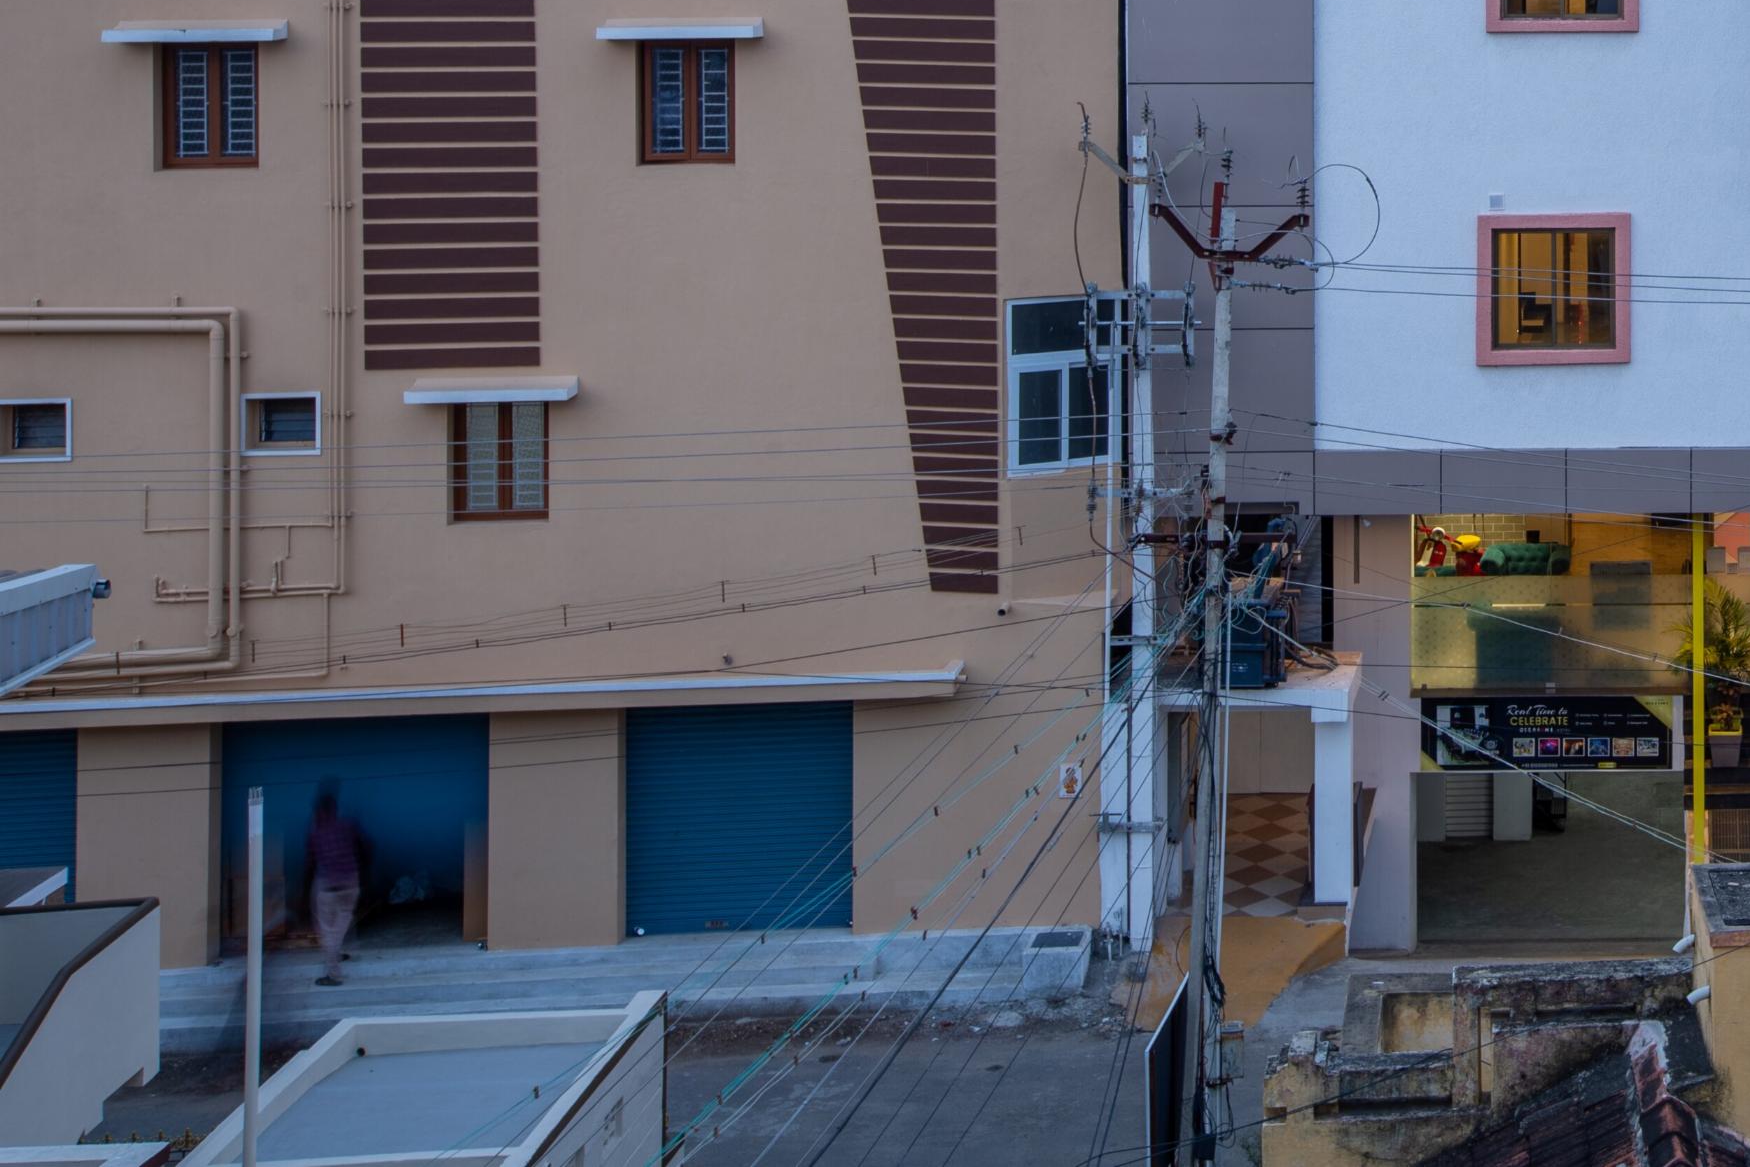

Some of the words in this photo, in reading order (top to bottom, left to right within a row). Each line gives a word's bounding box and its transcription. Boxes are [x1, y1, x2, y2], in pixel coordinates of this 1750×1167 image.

[1506, 704, 1533, 716] Real
[1533, 704, 1556, 716] Time
[1558, 706, 1569, 715] to
[1509, 716, 1569, 726] CELEBRATE
